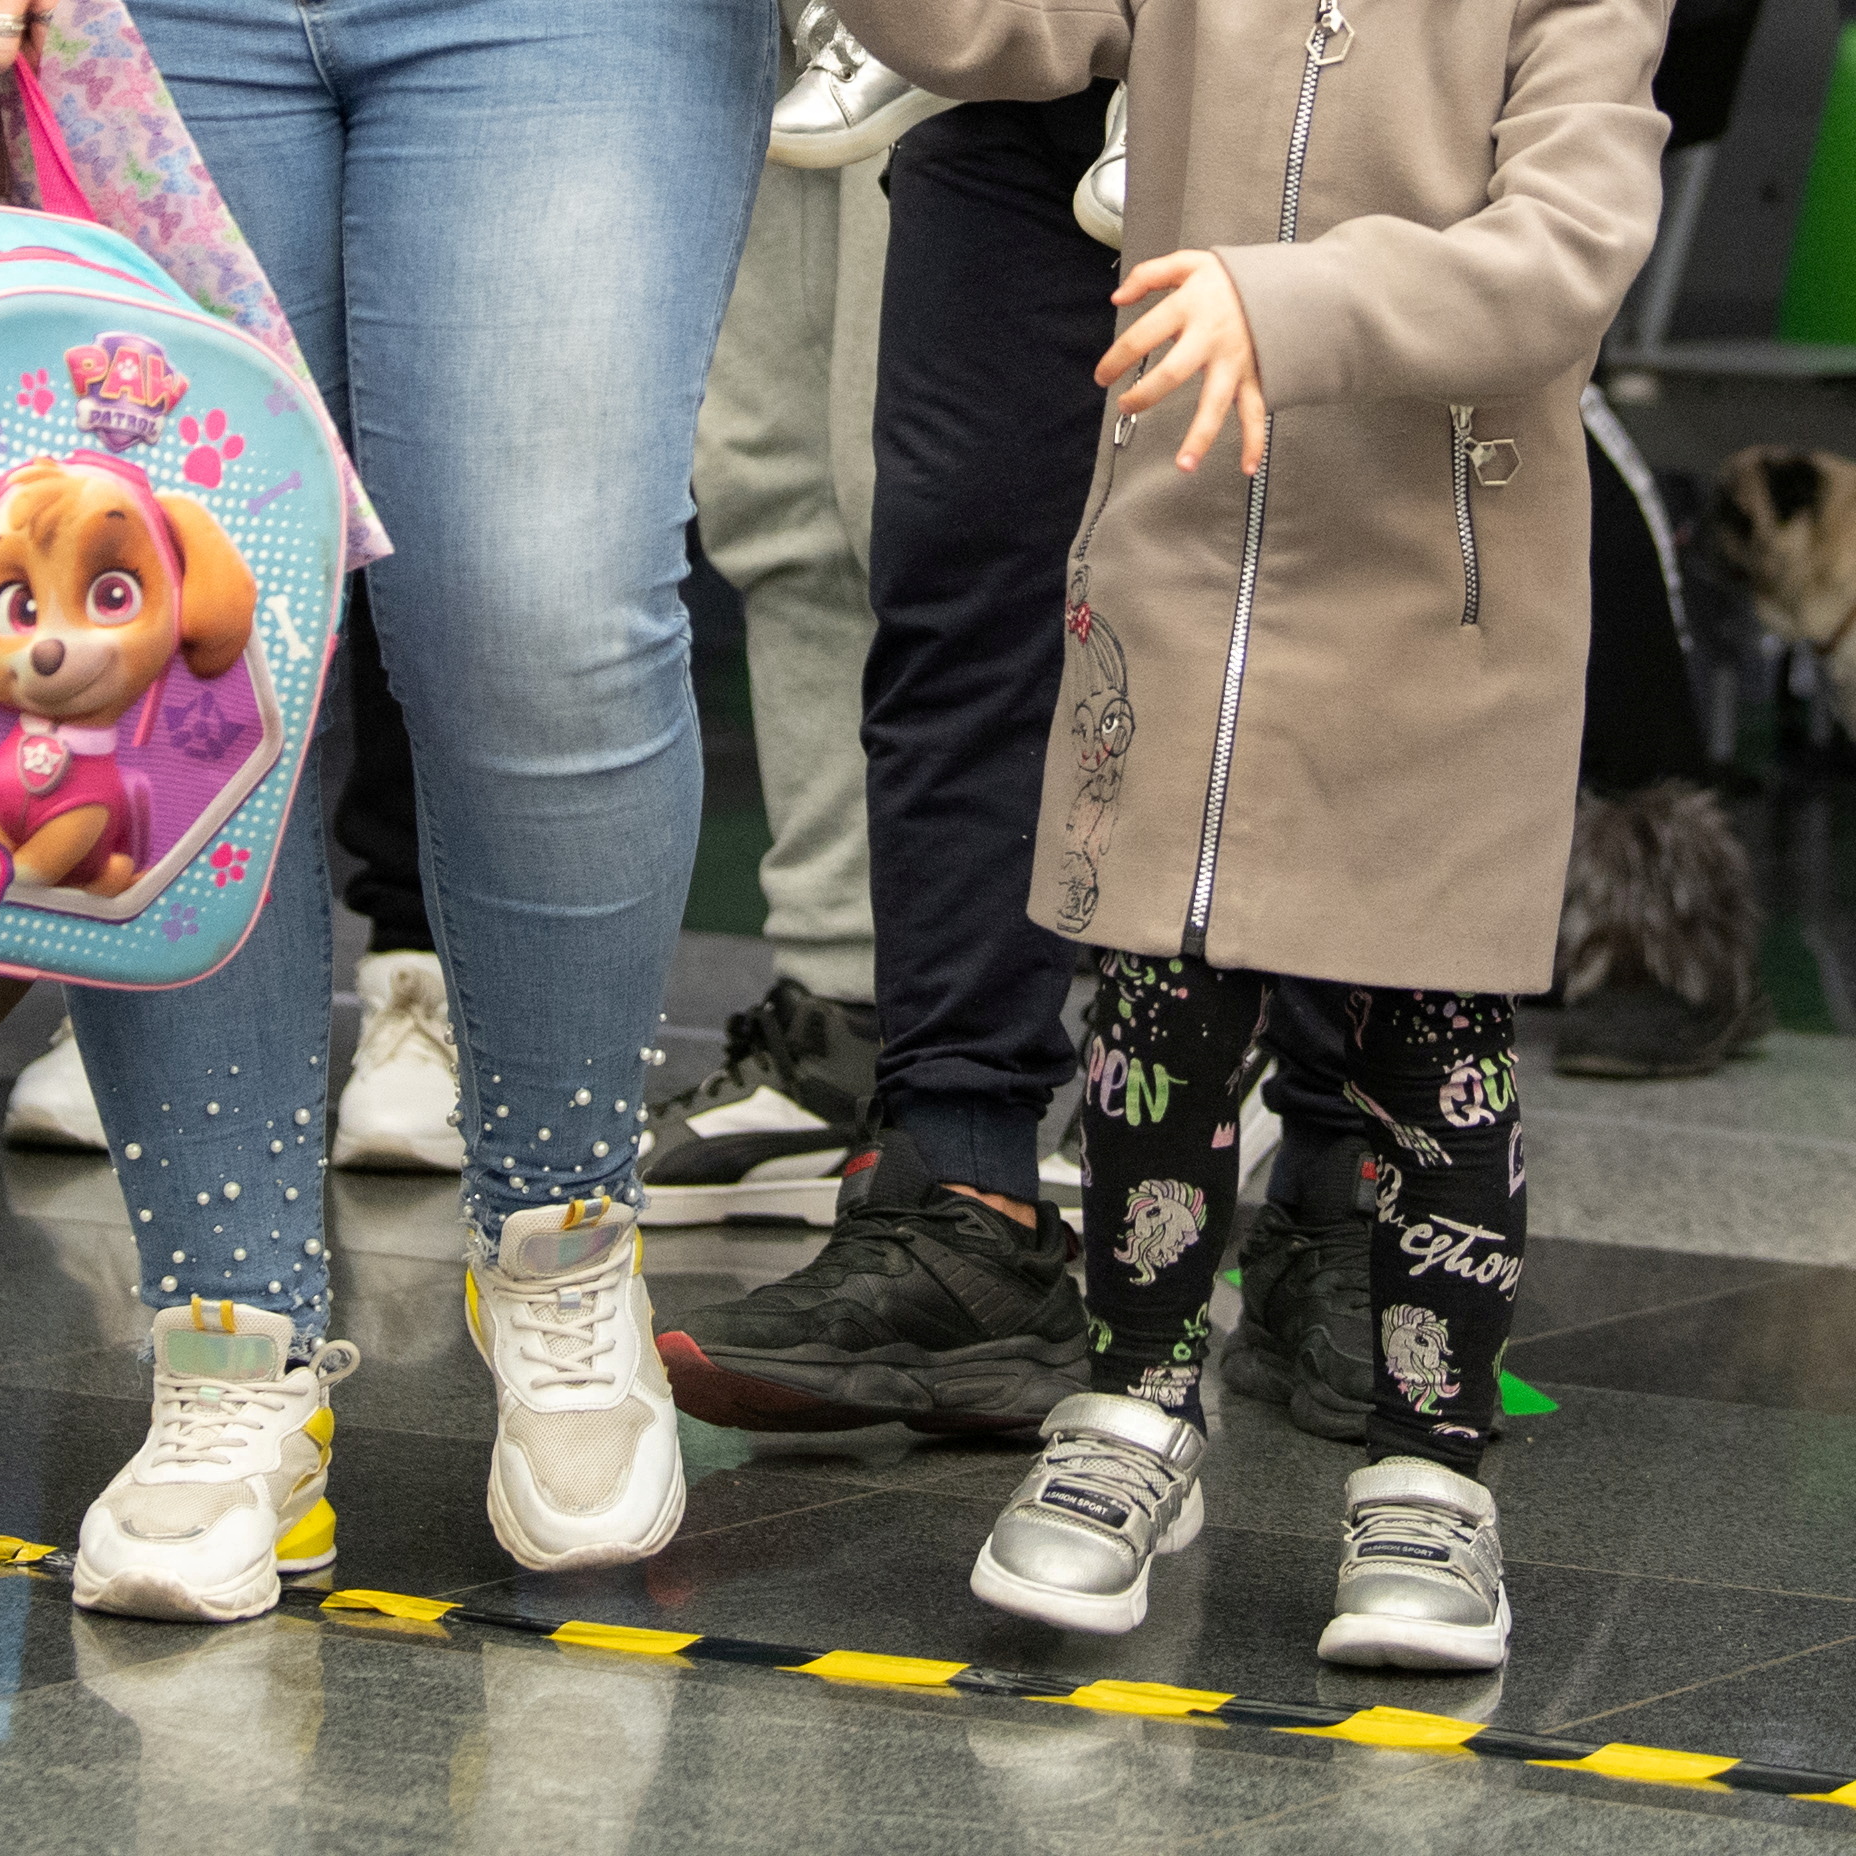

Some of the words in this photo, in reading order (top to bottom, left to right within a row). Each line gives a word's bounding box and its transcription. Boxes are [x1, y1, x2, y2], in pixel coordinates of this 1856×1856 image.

[64, 344, 190, 414] PAW
[88, 410, 159, 437] PATROL
[1044, 1491, 1077, 1505] ASHION
[1077, 1498, 1109, 1516] SPORT
[1361, 1544, 1401, 1554] FASHION
[1402, 1546, 1435, 1557] SPORT
